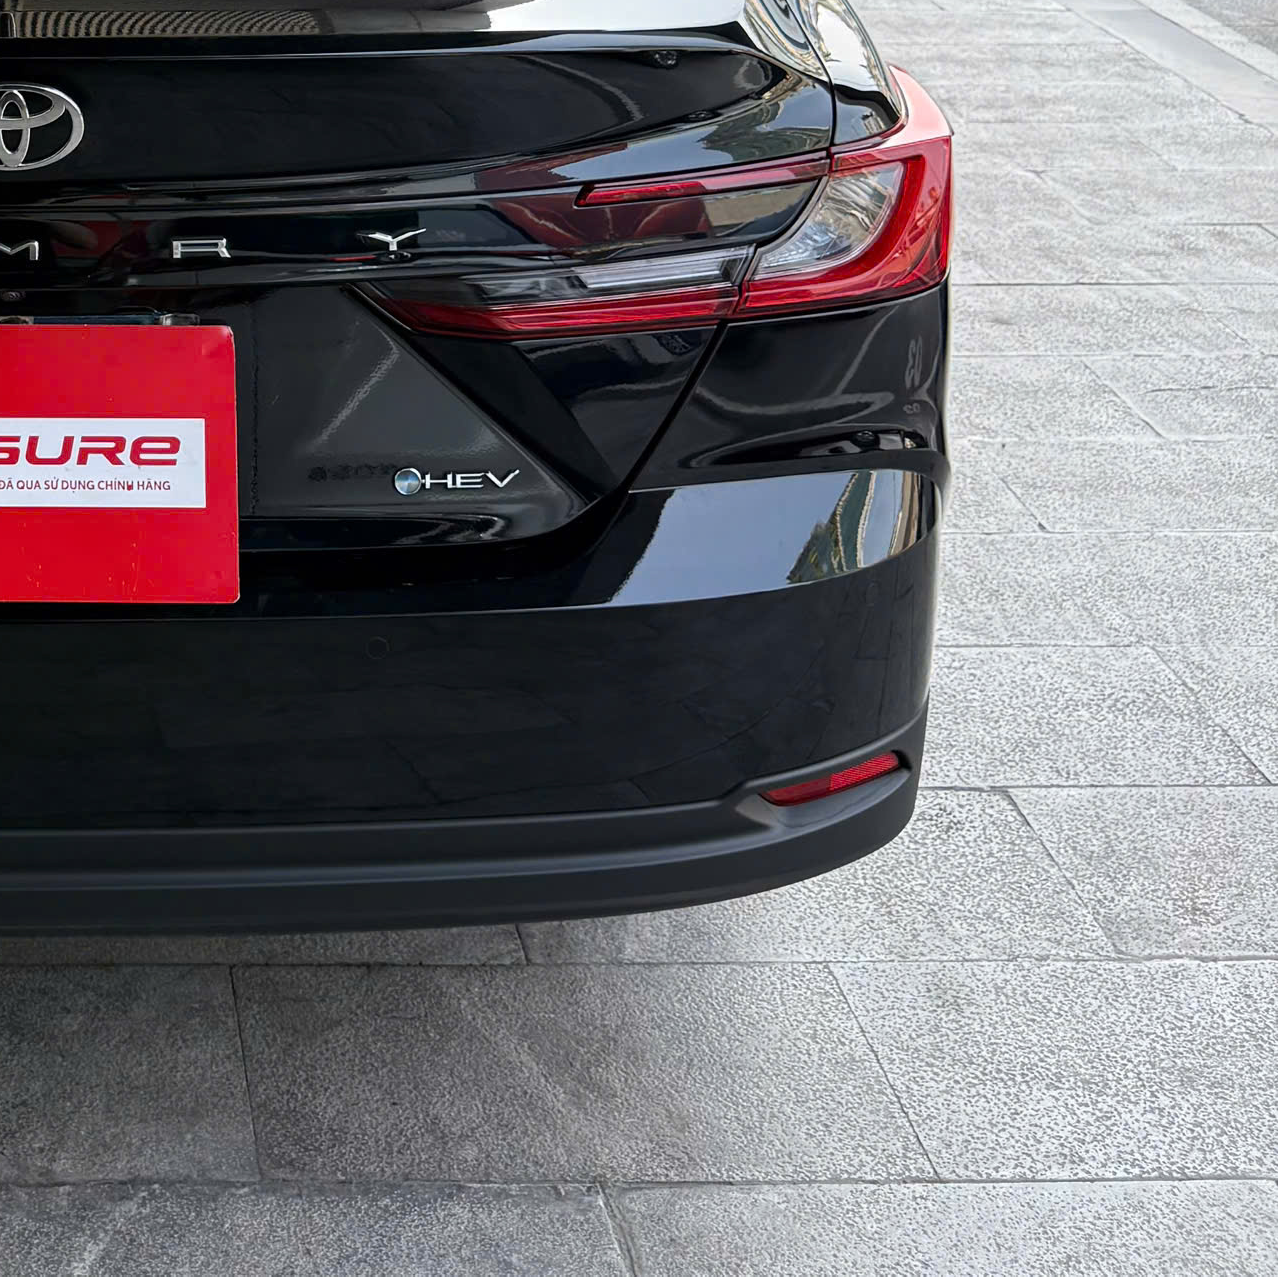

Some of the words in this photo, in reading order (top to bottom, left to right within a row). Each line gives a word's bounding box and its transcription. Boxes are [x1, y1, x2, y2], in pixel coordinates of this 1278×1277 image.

[16, 479, 42, 491] QUA
[44, 475, 59, 490] SỬ
[61, 479, 95, 493] DỤNG
[97, 476, 134, 491] CHÍNH
[424, 469, 520, 489] HEV
